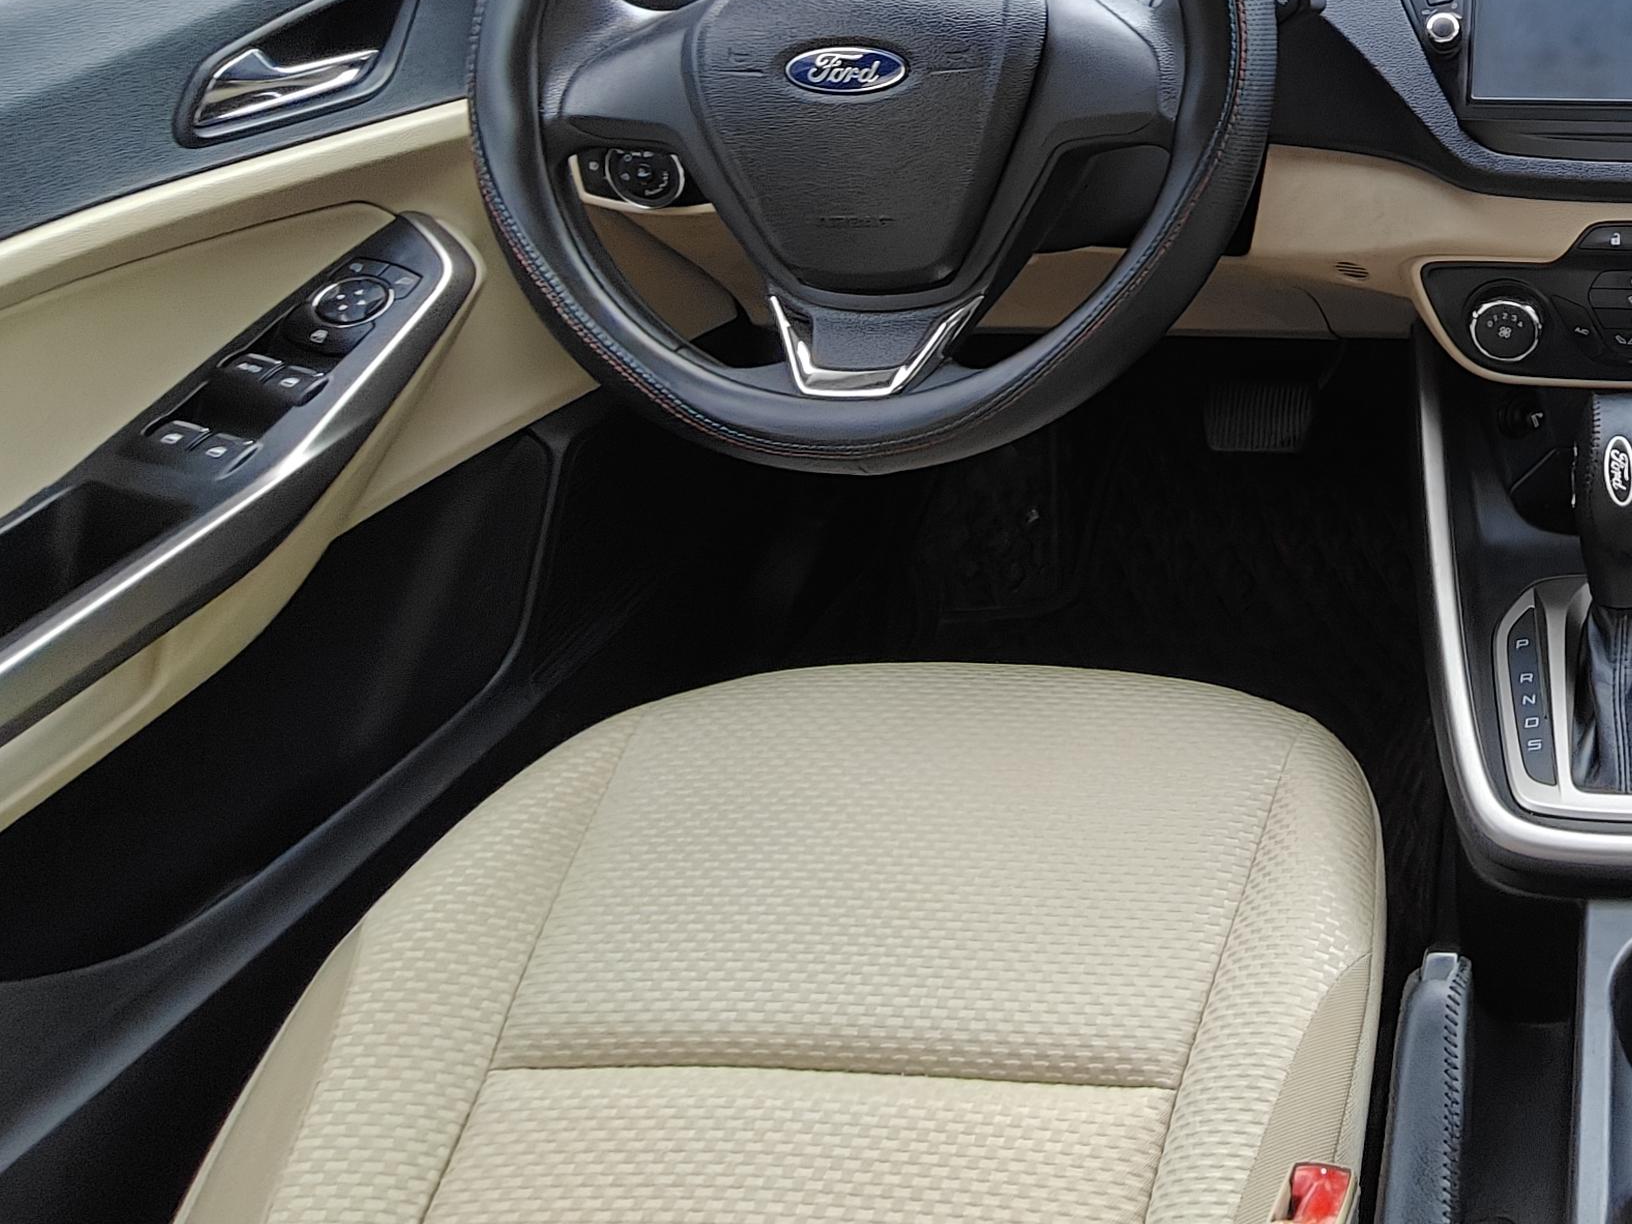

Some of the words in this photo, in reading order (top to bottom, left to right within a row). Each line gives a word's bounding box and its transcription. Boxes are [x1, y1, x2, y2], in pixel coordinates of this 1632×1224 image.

[807, 53, 881, 83] Ford
[1610, 448, 1629, 491] Ford
[1516, 639, 1529, 649] P
[1520, 673, 1534, 684] R
[1522, 694, 1536, 705] N
[1525, 717, 1539, 728] D
[1527, 739, 1542, 751] S
